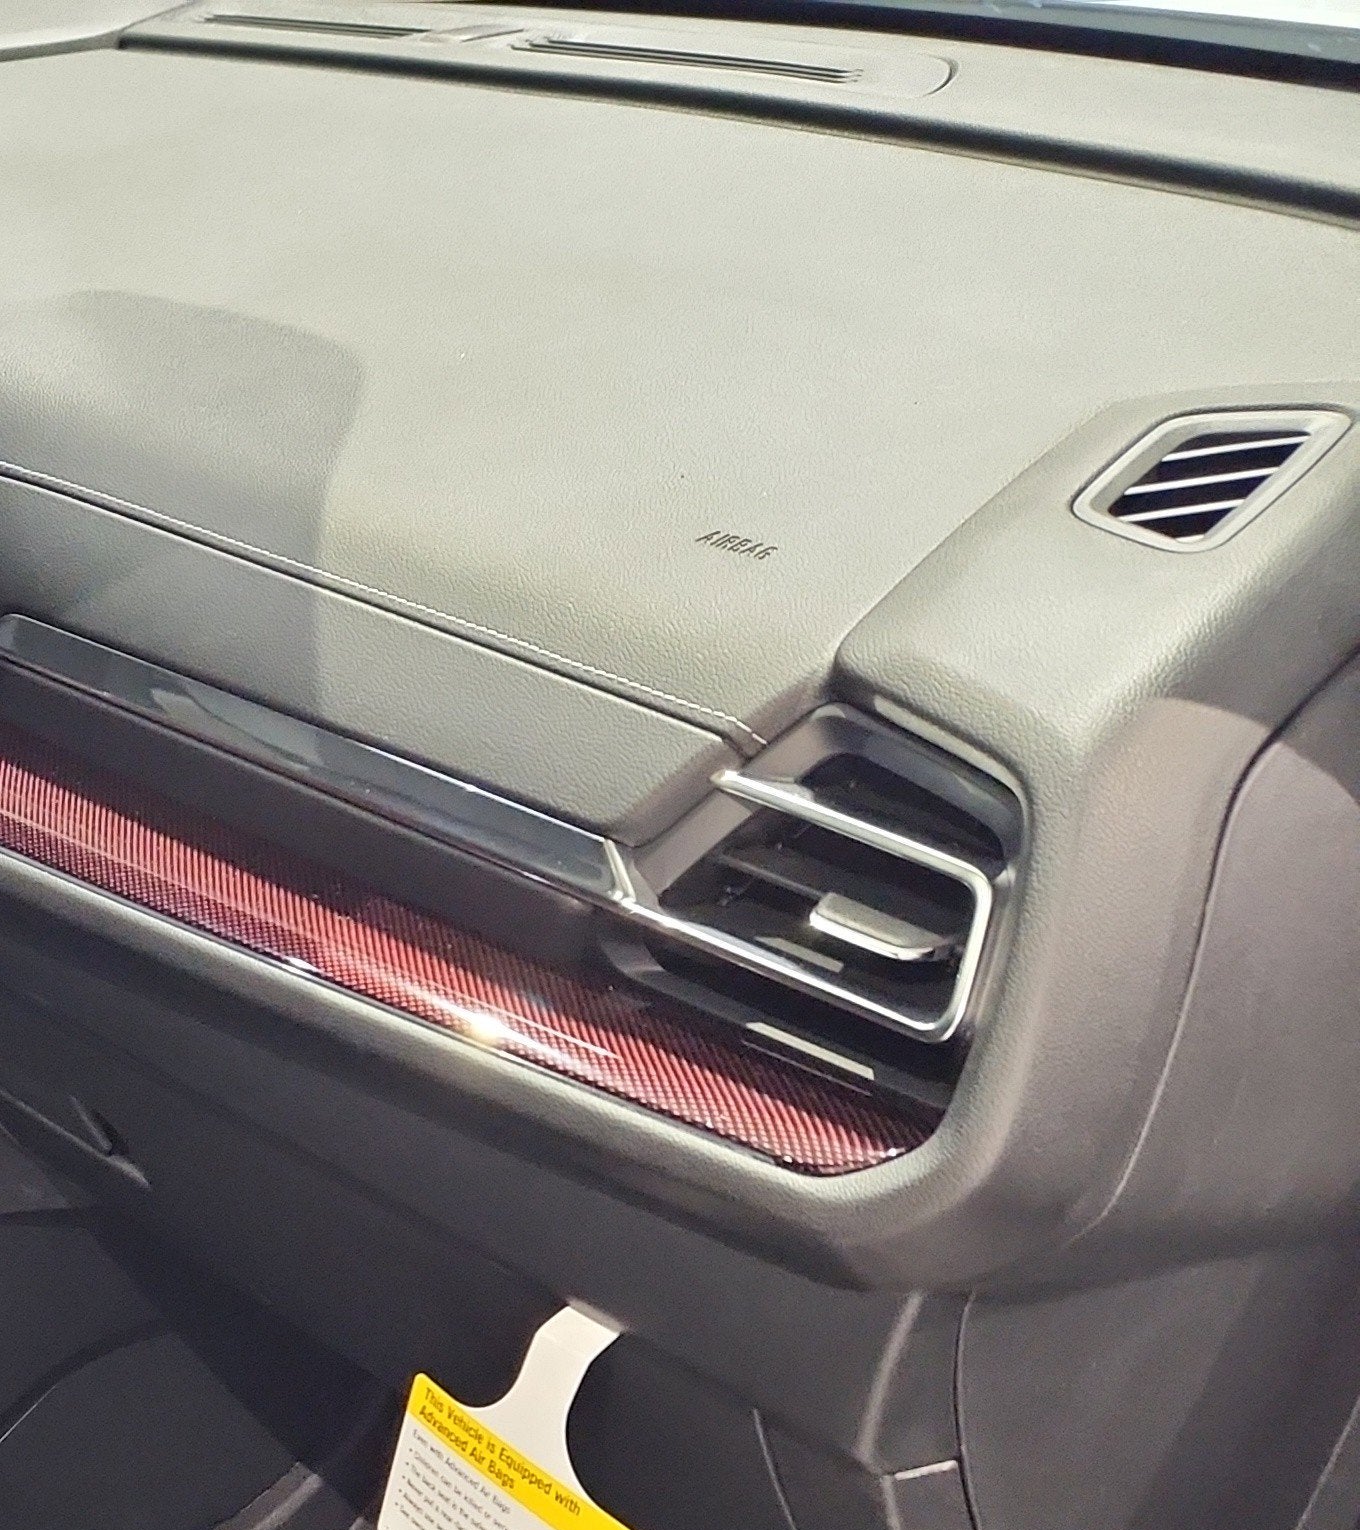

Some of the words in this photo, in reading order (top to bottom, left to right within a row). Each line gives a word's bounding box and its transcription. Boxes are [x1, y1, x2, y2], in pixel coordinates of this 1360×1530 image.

[695, 530, 778, 560] AIRBAG
[419, 1405, 469, 1453] Advanced
[469, 1446, 486, 1466] Air
[488, 1460, 514, 1489] Bags
[425, 1387, 444, 1413] This
[447, 1406, 484, 1444] Vehicle
[486, 1440, 496, 1454] is
[499, 1447, 553, 1495] Equipped
[555, 1490, 580, 1516] with
